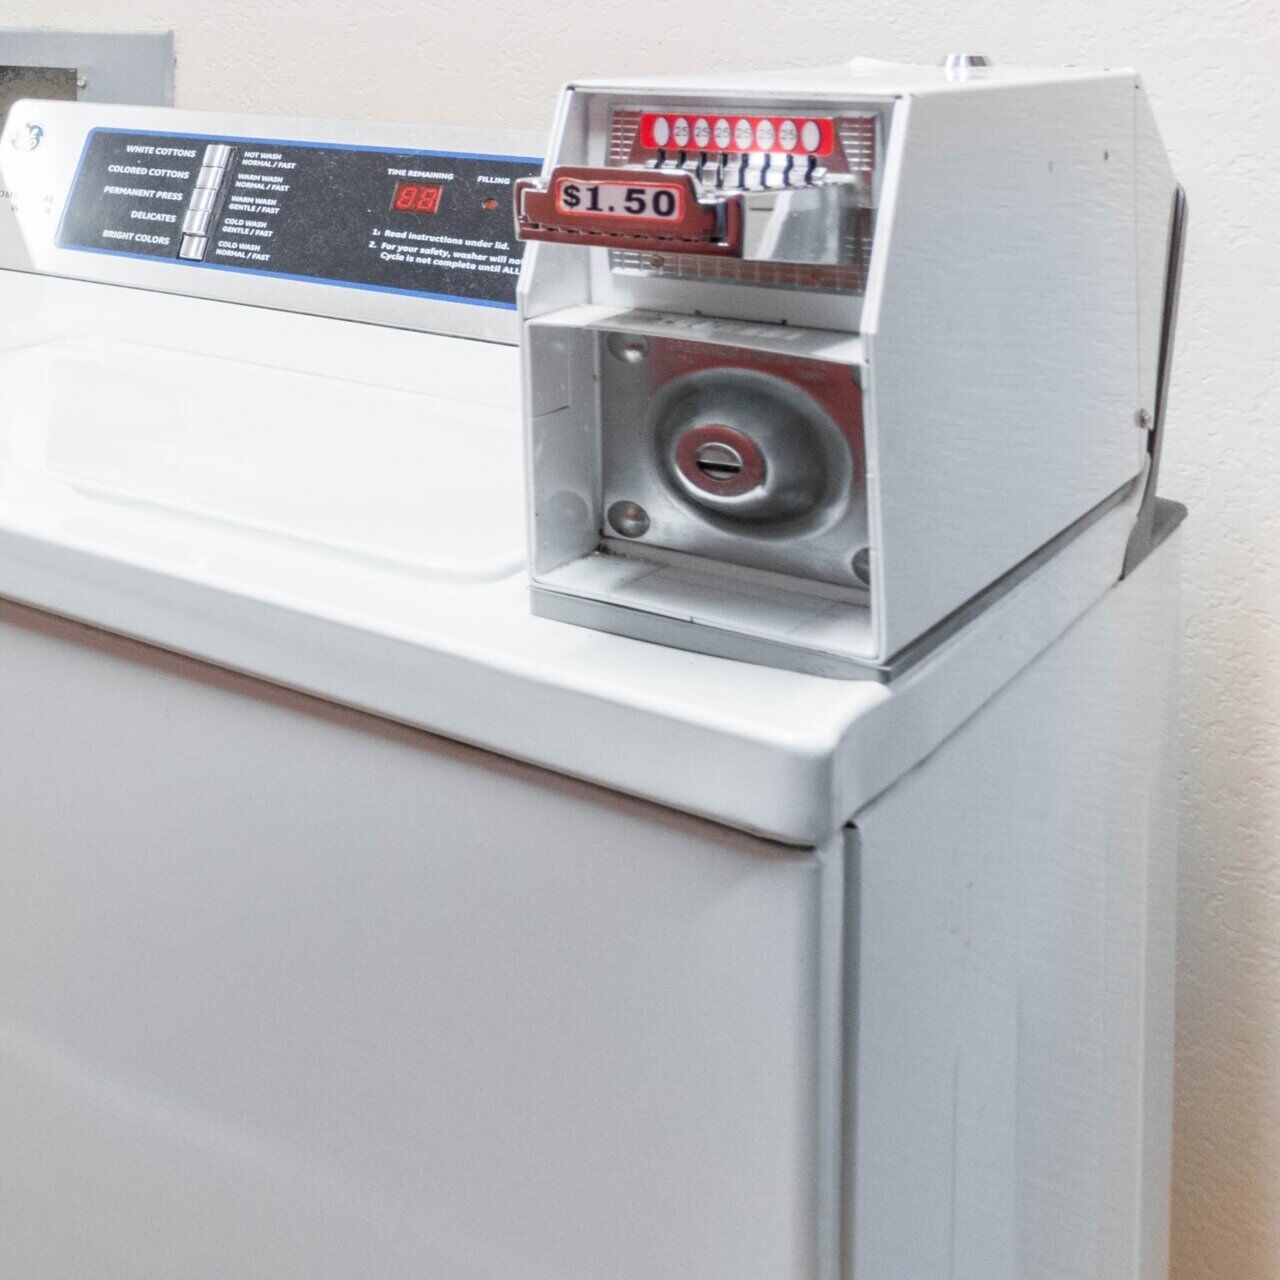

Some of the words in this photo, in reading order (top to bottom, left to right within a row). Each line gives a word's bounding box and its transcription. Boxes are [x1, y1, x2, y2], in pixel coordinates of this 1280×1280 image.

[675, 126, 689, 137] 25
[126, 145, 155, 155] WHITE
[155, 148, 198, 158] COTTONS
[244, 151, 259, 159] HOT
[260, 152, 282, 161] WASH
[242, 159, 272, 168] NORMAL
[278, 162, 298, 170] FAST
[108, 164, 148, 176] COLORED
[148, 169, 191, 180] COTTONS
[237, 173, 261, 181] WARM
[261, 175, 284, 184] WASH
[387, 167, 408, 178] TIME
[407, 169, 455, 181] REMAINING
[235, 181, 265, 190] NORMAL
[271, 184, 291, 192] FAST
[477, 174, 511, 186] FILLING
[104, 185, 156, 198] PERMANENT
[155, 190, 184, 201] PRESS
[396, 187, 436, 210] 88
[231, 195, 255, 204] WARM
[255, 197, 278, 206] WASH
[562, 184, 676, 217] $1.50
[228, 203, 257, 212] GENTLE
[261, 206, 281, 215] FAST
[130, 209, 177, 223] DELICATES
[224, 217, 245, 226] COLD
[245, 220, 268, 229] WASH
[102, 229, 135, 240] BRIGHT
[134, 233, 171, 245] COLORS
[221, 225, 250, 235] GENTLE
[255, 229, 274, 237] FAST
[217, 240, 238, 249] COLD
[238, 243, 261, 252] WASH
[385, 229, 408, 239] Read
[408, 231, 464, 245] instructions
[465, 239, 494, 249] under
[494, 241, 510, 251] lid.
[215, 248, 245, 259] NORMAL
[251, 252, 271, 261] FAST
[368, 240, 377, 249] 2.
[381, 242, 396, 250] For
[396, 245, 419, 253] your
[453, 251, 488, 261] washer
[490, 255, 507, 264] will
[380, 251, 405, 262] Cycle
[406, 254, 415, 263] is
[433, 259, 476, 270] complete
[478, 264, 501, 273] until
[502, 266, 521, 276] ALL
